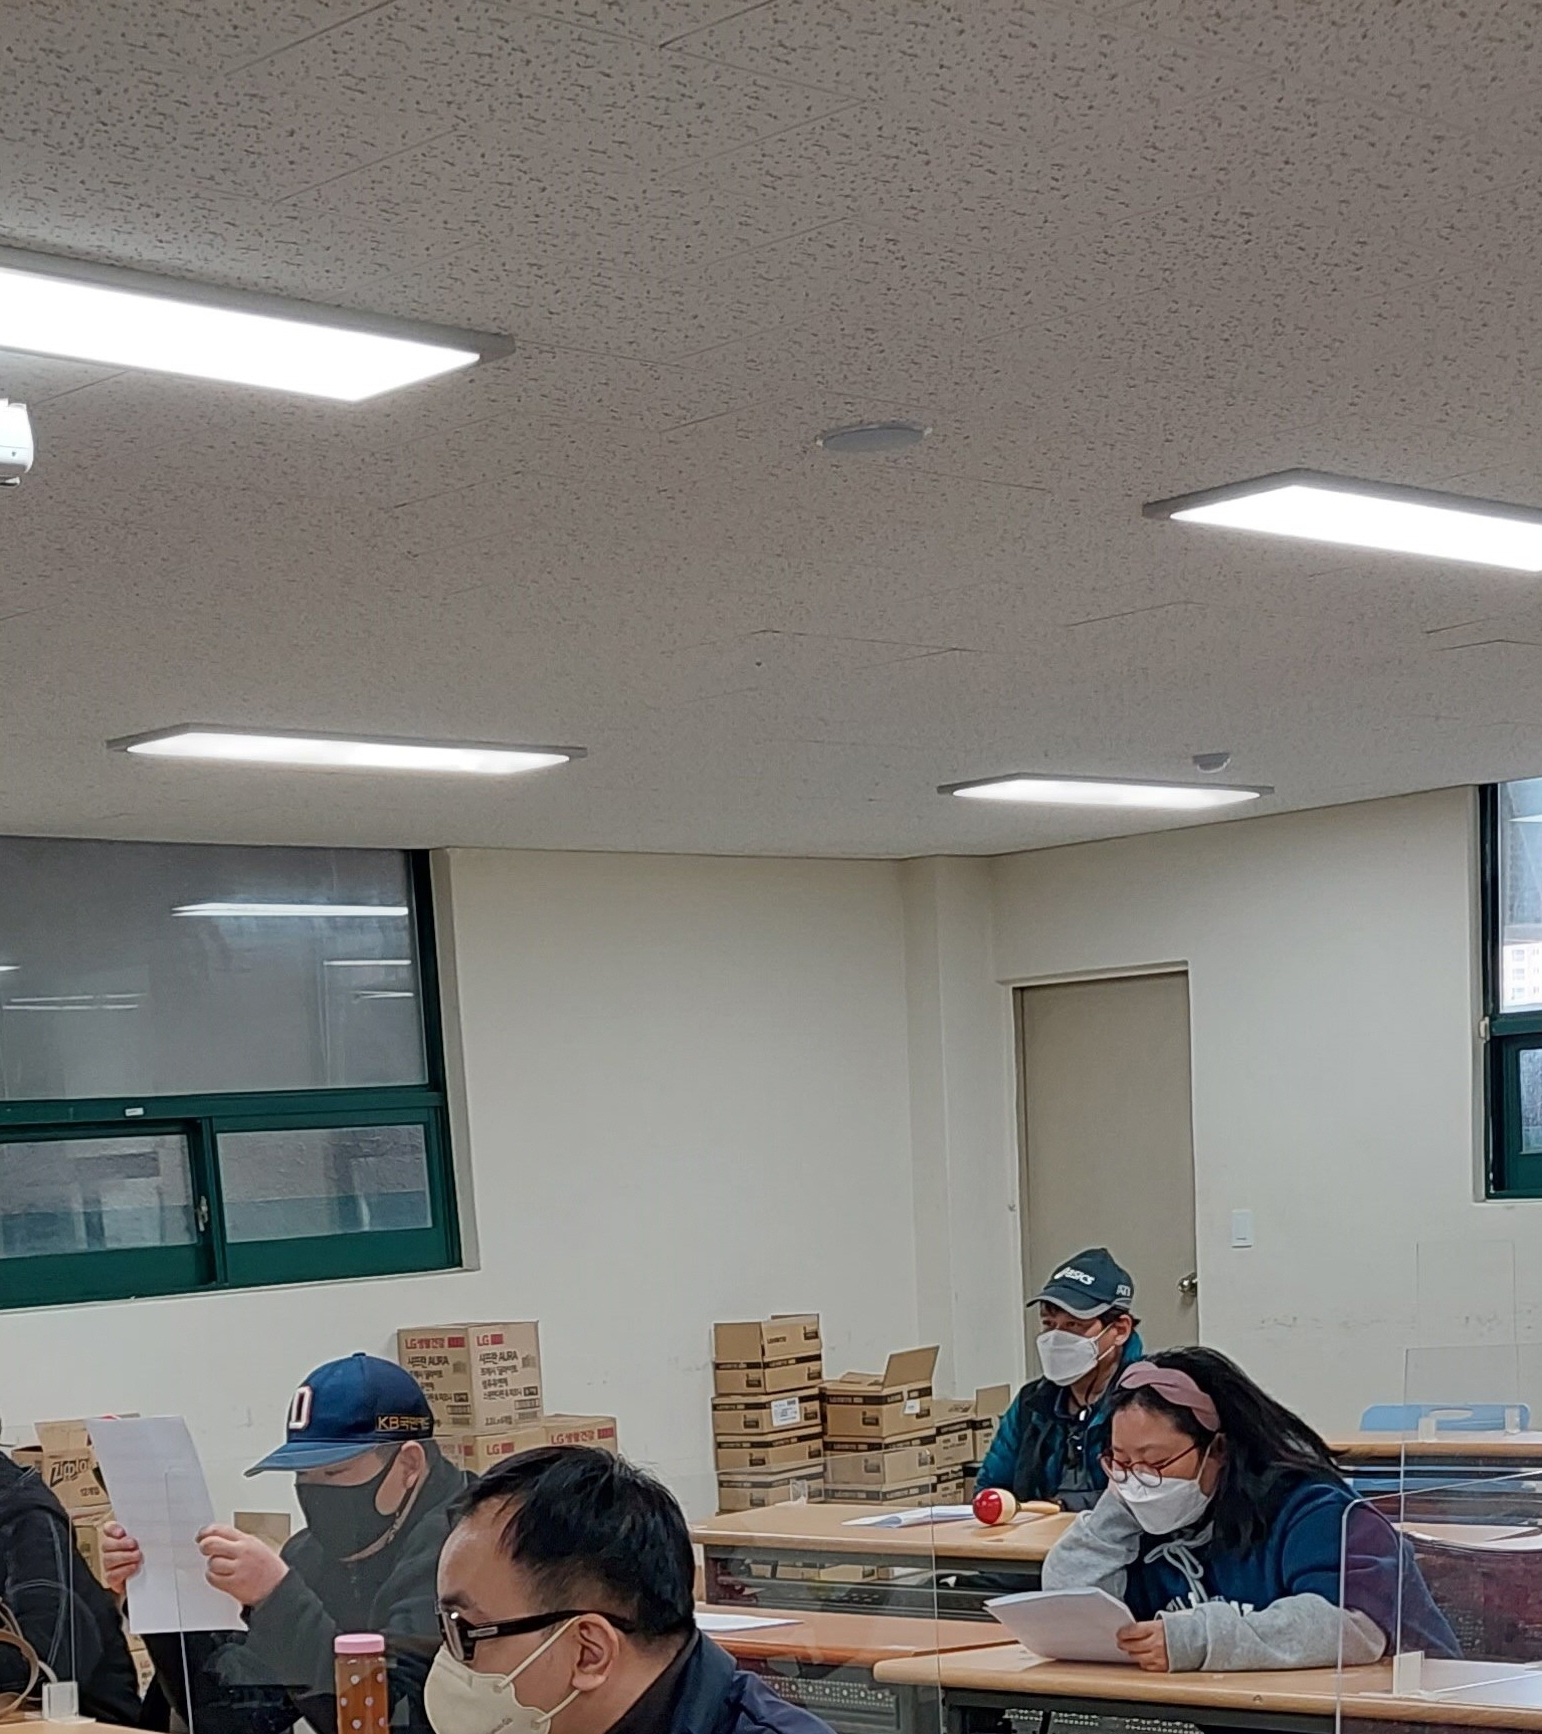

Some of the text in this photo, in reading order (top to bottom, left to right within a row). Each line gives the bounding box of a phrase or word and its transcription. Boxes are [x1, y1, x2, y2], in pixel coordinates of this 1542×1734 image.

[476, 1334, 490, 1347] LG
[550, 1429, 595, 1446] LG생활건강
[486, 1444, 501, 1456] LG
